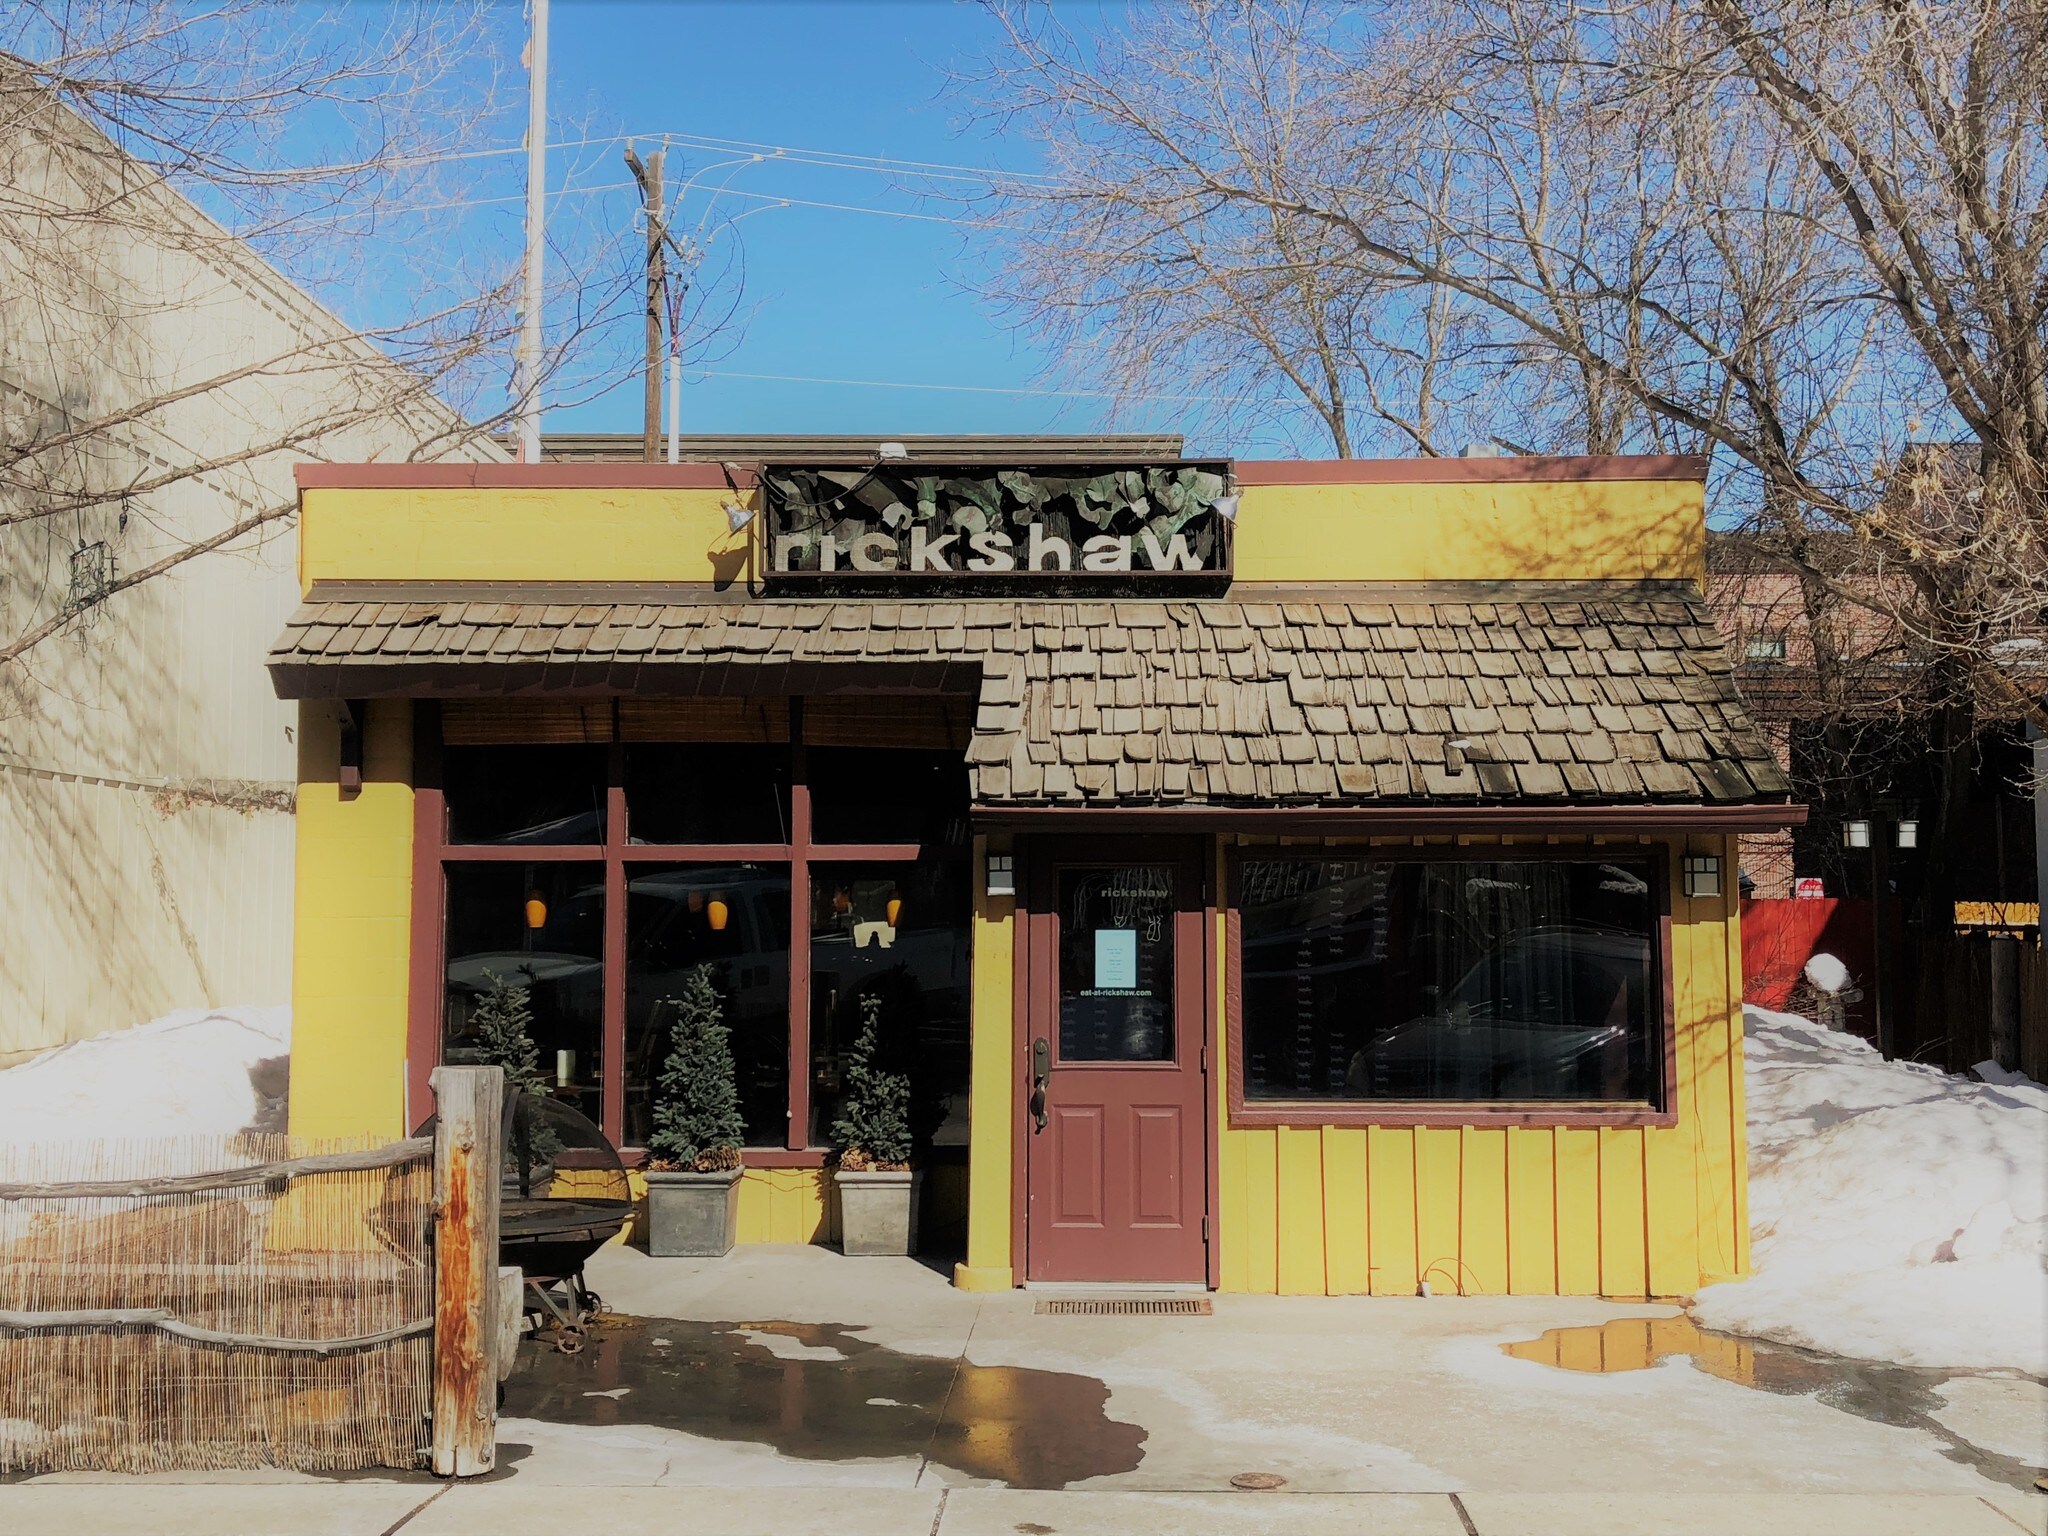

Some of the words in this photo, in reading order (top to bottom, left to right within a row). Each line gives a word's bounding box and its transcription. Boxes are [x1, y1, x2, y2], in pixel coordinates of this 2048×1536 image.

[775, 522, 1205, 572] rickshaw
[1101, 887, 1169, 898] rickshaw
[1080, 989, 1152, 997] eat-at-rickshaw.com
